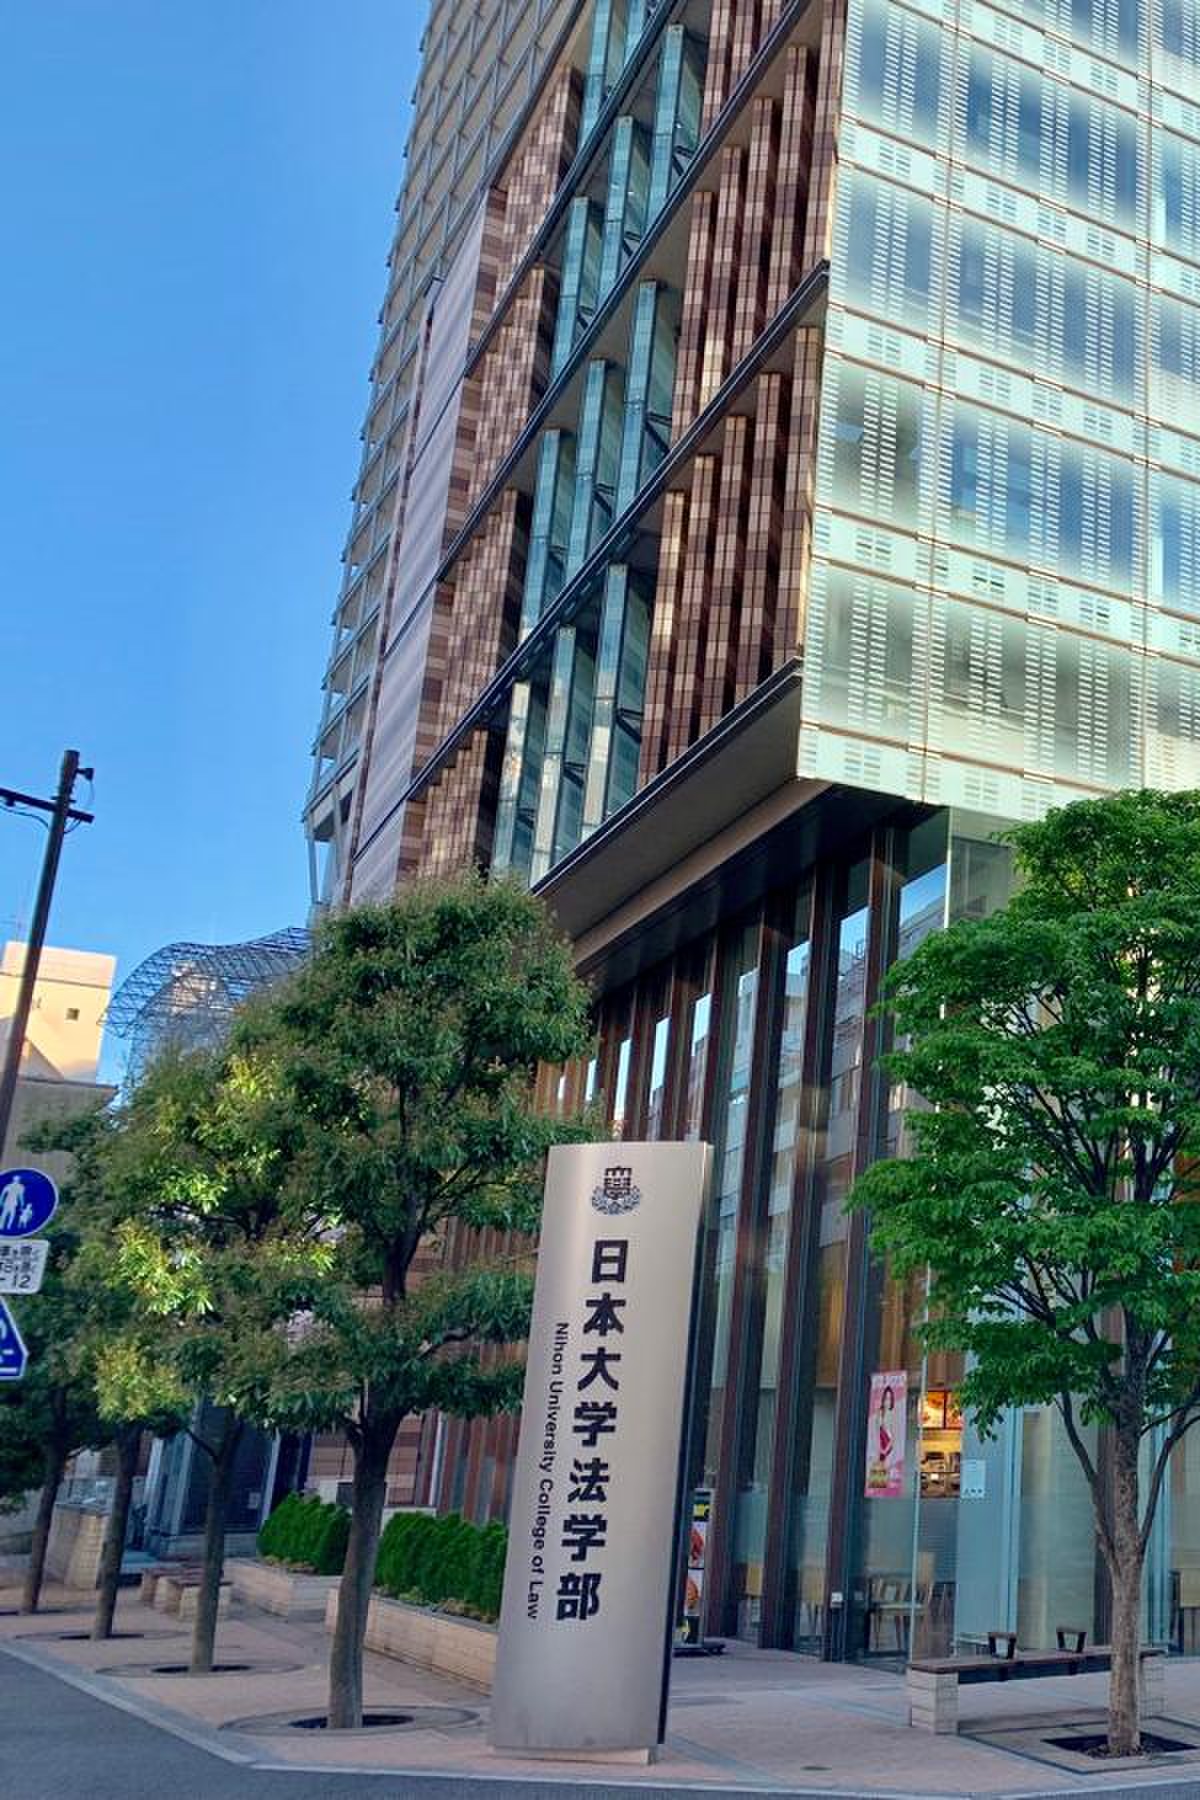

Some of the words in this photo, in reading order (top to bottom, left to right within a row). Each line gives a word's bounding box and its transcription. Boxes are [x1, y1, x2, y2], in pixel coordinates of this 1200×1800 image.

[552, 1322, 569, 1375] Nihon
[539, 1381, 564, 1472] University
[556, 1239, 629, 1620] 日本大学法学部
[532, 1479, 553, 1549] College
[531, 1555, 545, 1574] of
[527, 1581, 544, 1619] Law
